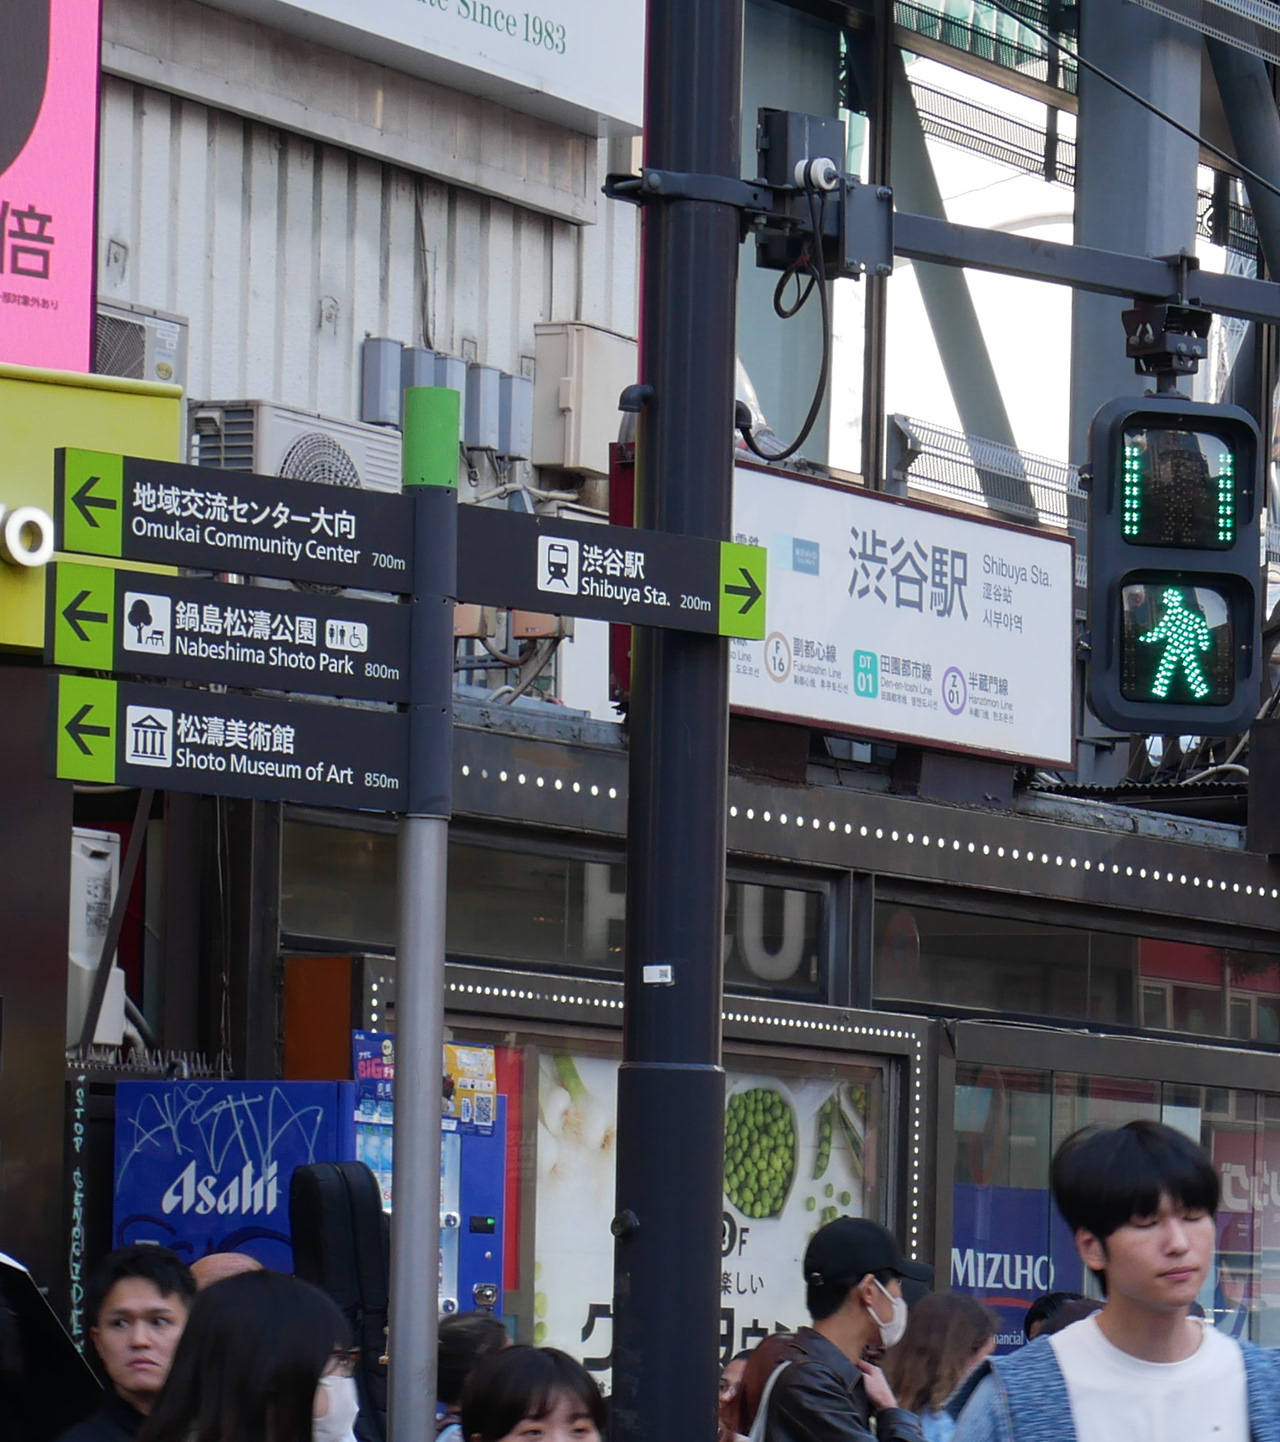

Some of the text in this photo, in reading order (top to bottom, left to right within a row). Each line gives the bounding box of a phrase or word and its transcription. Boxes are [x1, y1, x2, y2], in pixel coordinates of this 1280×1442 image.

[524, 13, 566, 54] 1983
[132, 482, 356, 540] 地域交流センター大向
[132, 517, 406, 570] Omukai Community Center 700m
[582, 544, 645, 580] 渋谷駅
[849, 527, 969, 621] 渋谷駅
[982, 553, 1053, 588] Shibuya Sta.
[581, 577, 711, 612] Shibuya Sta. 200m
[175, 601, 318, 646] 鍋島松濤公園
[982, 609, 1023, 633] 시부야역
[175, 635, 400, 680] Nabeshima Shoto Park 800m
[772, 657, 785, 672] 16
[793, 638, 837, 663] 副都心線
[859, 655, 872, 668] DT
[880, 654, 933, 682] 田園都市線
[793, 661, 842, 679] Fukutoshin Line
[857, 674, 873, 693] 01
[968, 672, 1009, 696] 半蔵門線
[919, 683, 933, 696] Line
[948, 689, 960, 705] 01
[1000, 699, 1013, 711] Line
[176, 714, 296, 754] 松濤美術館
[176, 749, 399, 790] Shoto Museum of Art 850m
[161, 1159, 279, 1216] Asahi
[950, 1247, 1055, 1291] MIZUHO
